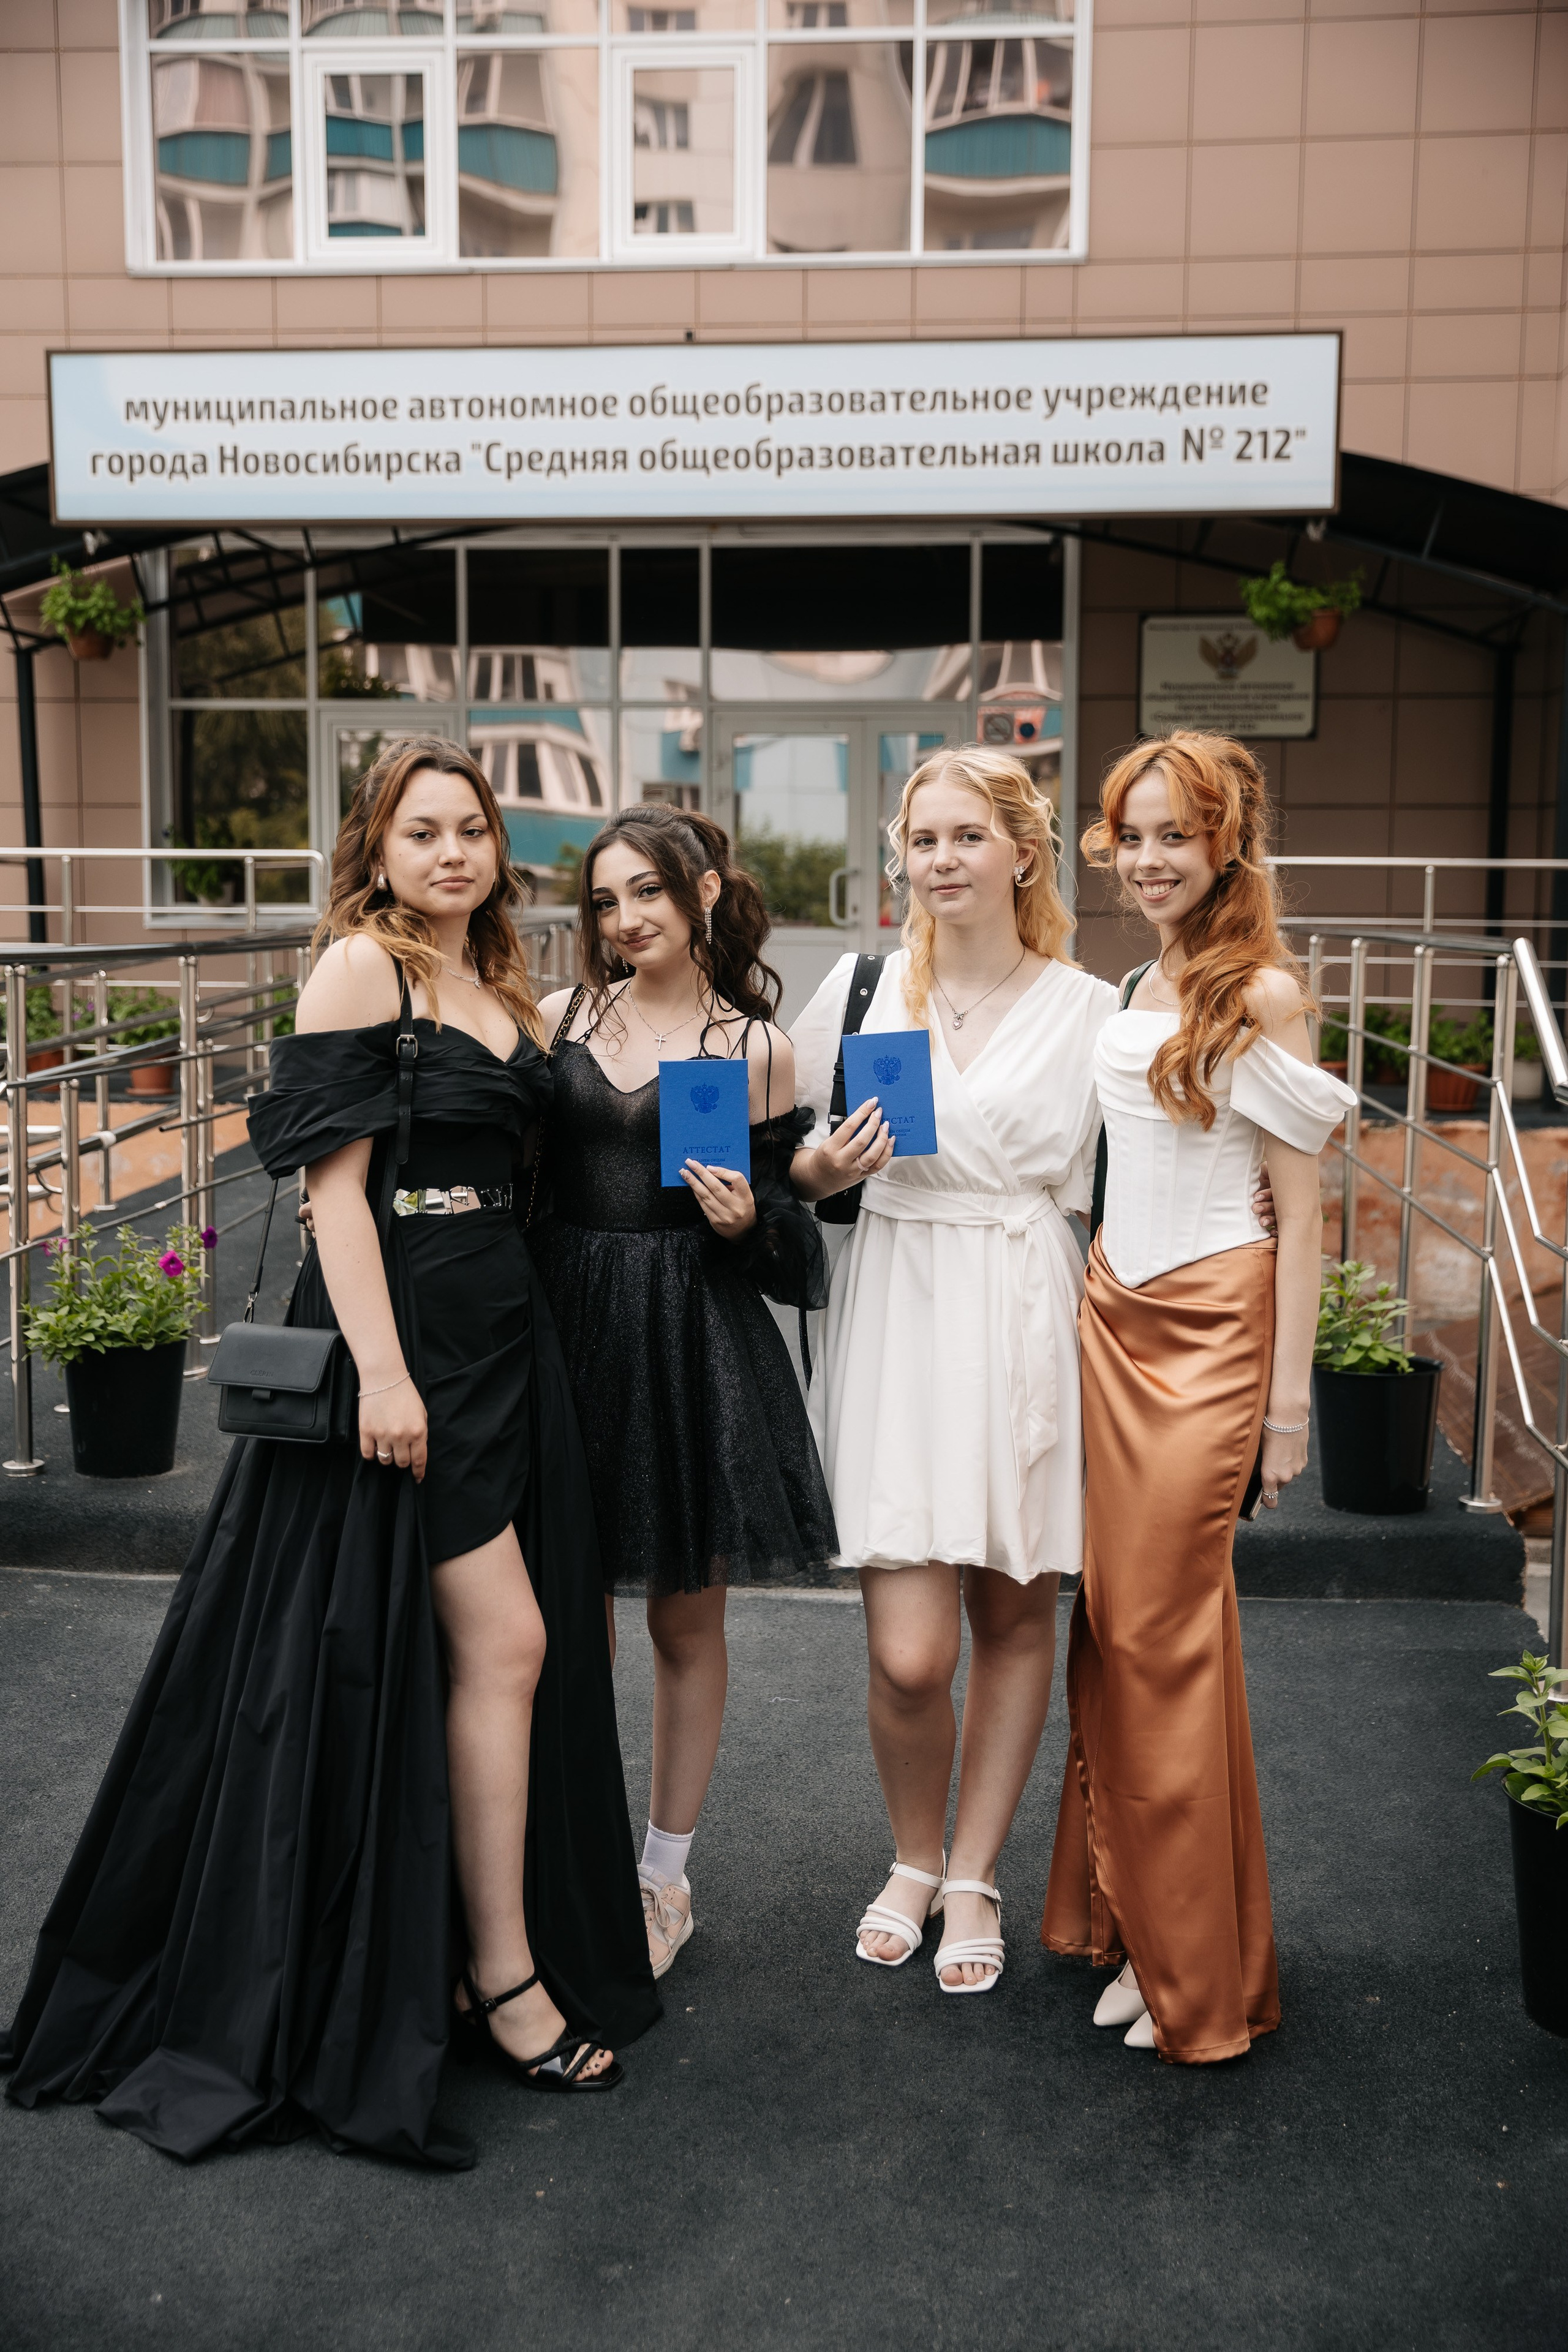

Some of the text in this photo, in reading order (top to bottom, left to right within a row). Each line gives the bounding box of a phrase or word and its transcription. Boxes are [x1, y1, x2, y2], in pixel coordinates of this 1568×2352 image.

[124, 382, 1268, 428] муниципальное автономное общеобразовательное учреждение
[91, 425, 1306, 482] города Новосибирска "Средняя общеобразовательная школа № 212"
